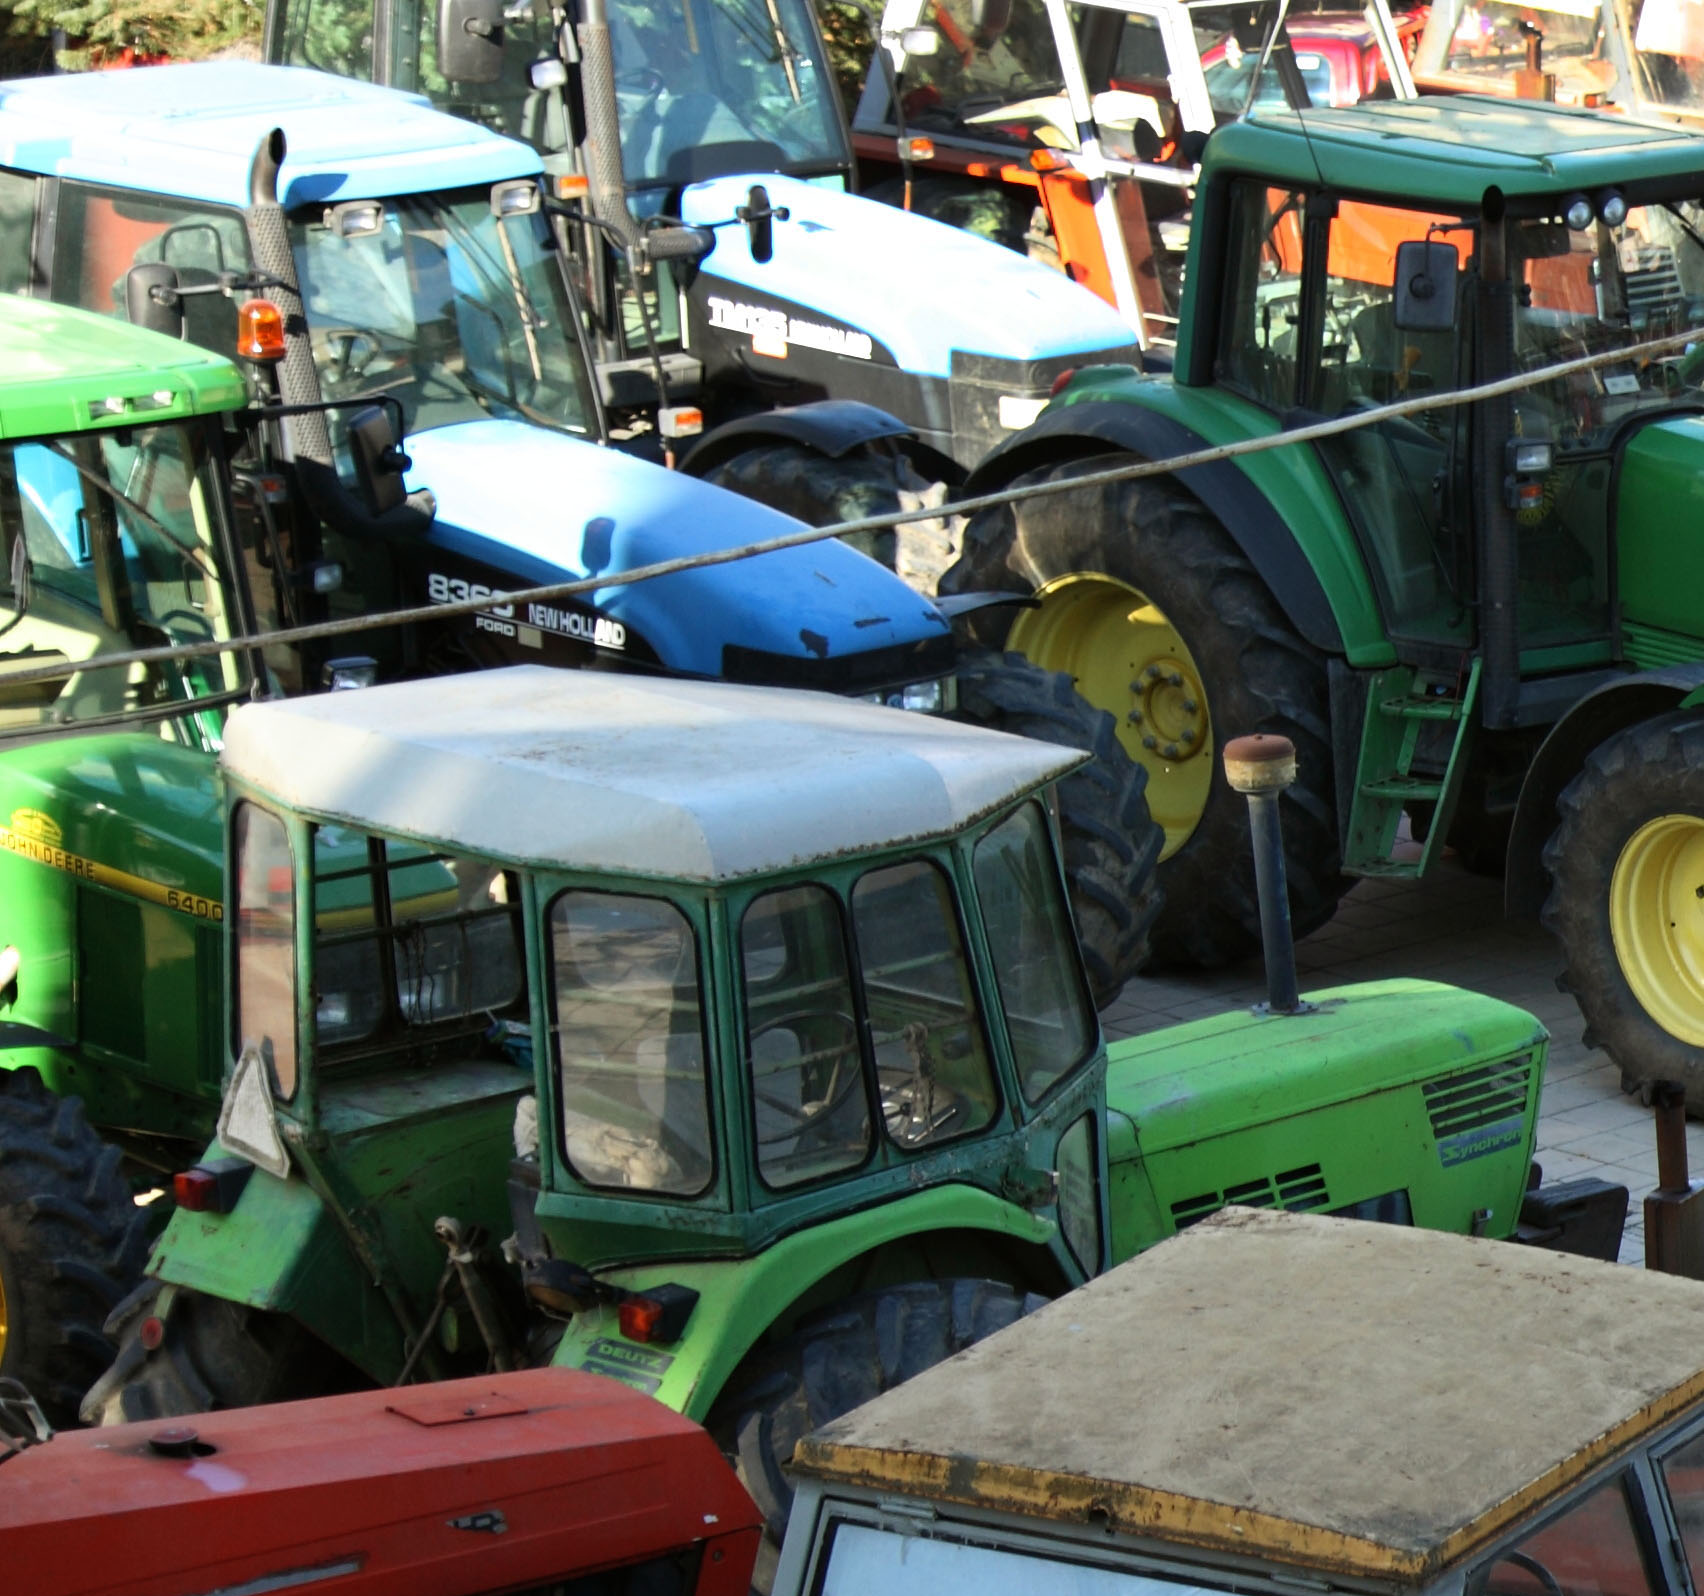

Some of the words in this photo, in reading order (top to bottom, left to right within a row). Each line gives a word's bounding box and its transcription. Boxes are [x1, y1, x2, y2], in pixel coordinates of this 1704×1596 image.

[476, 617, 516, 637] FORD
[42, 846, 95, 880] DEERE
[167, 890, 223, 922] 6400
[598, 1343, 662, 1369] DEUTZ
